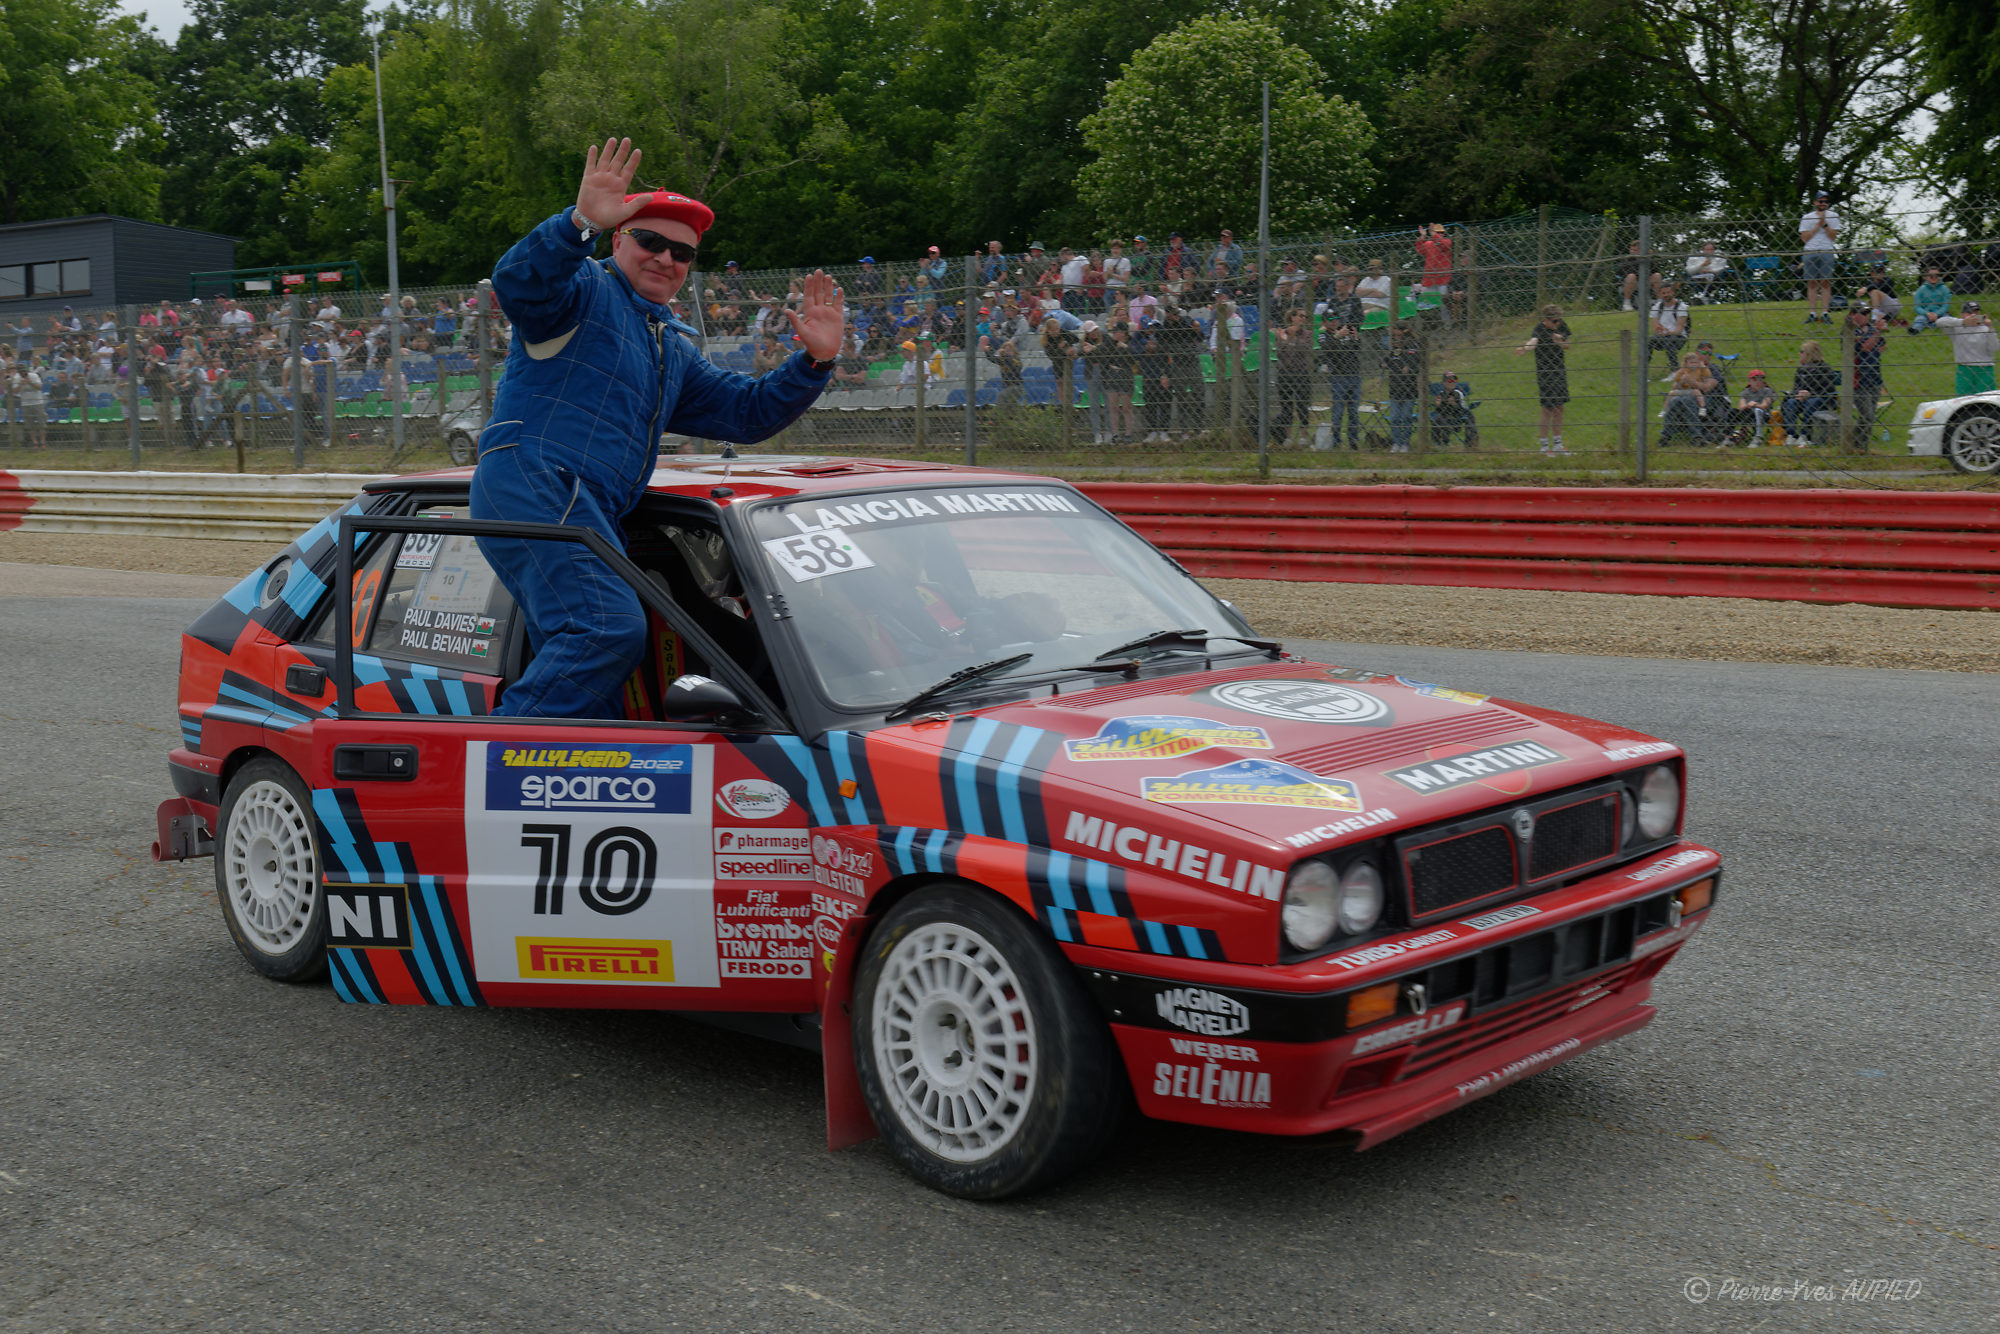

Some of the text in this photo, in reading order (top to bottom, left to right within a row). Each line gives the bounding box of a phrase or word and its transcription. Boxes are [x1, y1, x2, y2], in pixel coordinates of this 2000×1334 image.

[786, 494, 1080, 533] LANCIA MARTINI
[783, 534, 853, 574] 58
[403, 608, 477, 634] PAUL DAVIES
[400, 629, 471, 655] PAUL BEVAN
[501, 749, 684, 769] RALLYLEGEND 2022
[1075, 736, 1206, 759] COMPETITOR
[1395, 741, 1560, 790] MARTINI
[521, 775, 656, 808] sparco
[1287, 808, 1397, 848] MICHELIN
[738, 834, 808, 850] pharmage
[720, 858, 810, 877] speedline
[1064, 811, 1286, 901] MICHELIN
[520, 823, 657, 916] 10
[814, 864, 865, 898] BILSTEIN
[747, 890, 779, 903] Fiat
[812, 893, 858, 920] SKF
[328, 896, 399, 938] NI
[716, 903, 811, 917] Lubrificanti
[530, 945, 659, 974] PIRELLI
[718, 940, 762, 957] TRW
[1326, 943, 1406, 969] TURBO
[727, 961, 803, 975] FERODO
[1169, 1038, 1260, 1062] WEBER
